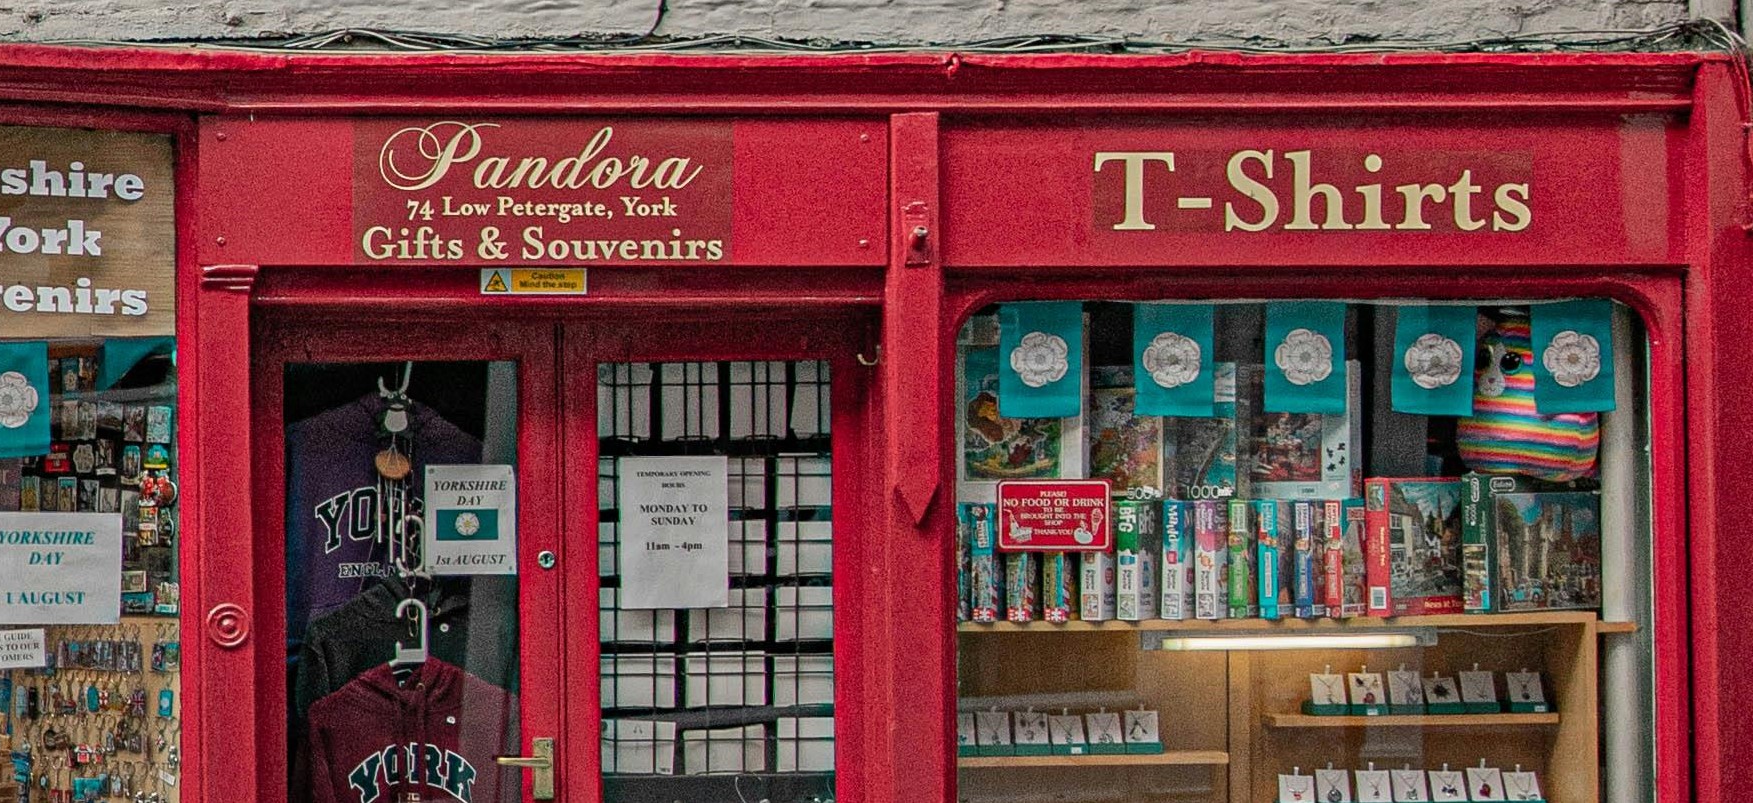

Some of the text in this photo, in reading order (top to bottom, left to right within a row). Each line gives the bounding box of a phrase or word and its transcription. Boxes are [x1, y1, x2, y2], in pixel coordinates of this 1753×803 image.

[379, 120, 703, 190] Pandora
[1093, 149, 1533, 232] T-Shirts
[407, 197, 677, 223] 74 Low Petergate, York
[362, 226, 723, 261] Gifts & Souvenirs
[519, 280, 577, 289] Mind the step
[433, 480, 507, 491] YORKSHIRE
[456, 495, 484, 506] DAY
[1003, 498, 1104, 507] NO FOOD OR DRINK
[640, 504, 708, 513] MONDAY TO
[651, 516, 696, 525] SUNDAY
[1020, 512, 1053, 520] BROUGHT
[1118, 507, 1137, 532] BFG
[646, 542, 670, 551] 11am
[681, 542, 703, 551] 4pm
[29, 552, 64, 565] DAY
[435, 554, 507, 565] 1st AUGUST
[6, 592, 86, 605] 1 AUGUST
[3, 631, 33, 642] GUIDE
[6, 643, 19, 652] TO
[19, 642, 40, 651] OUR
[348, 742, 477, 803] YORK
